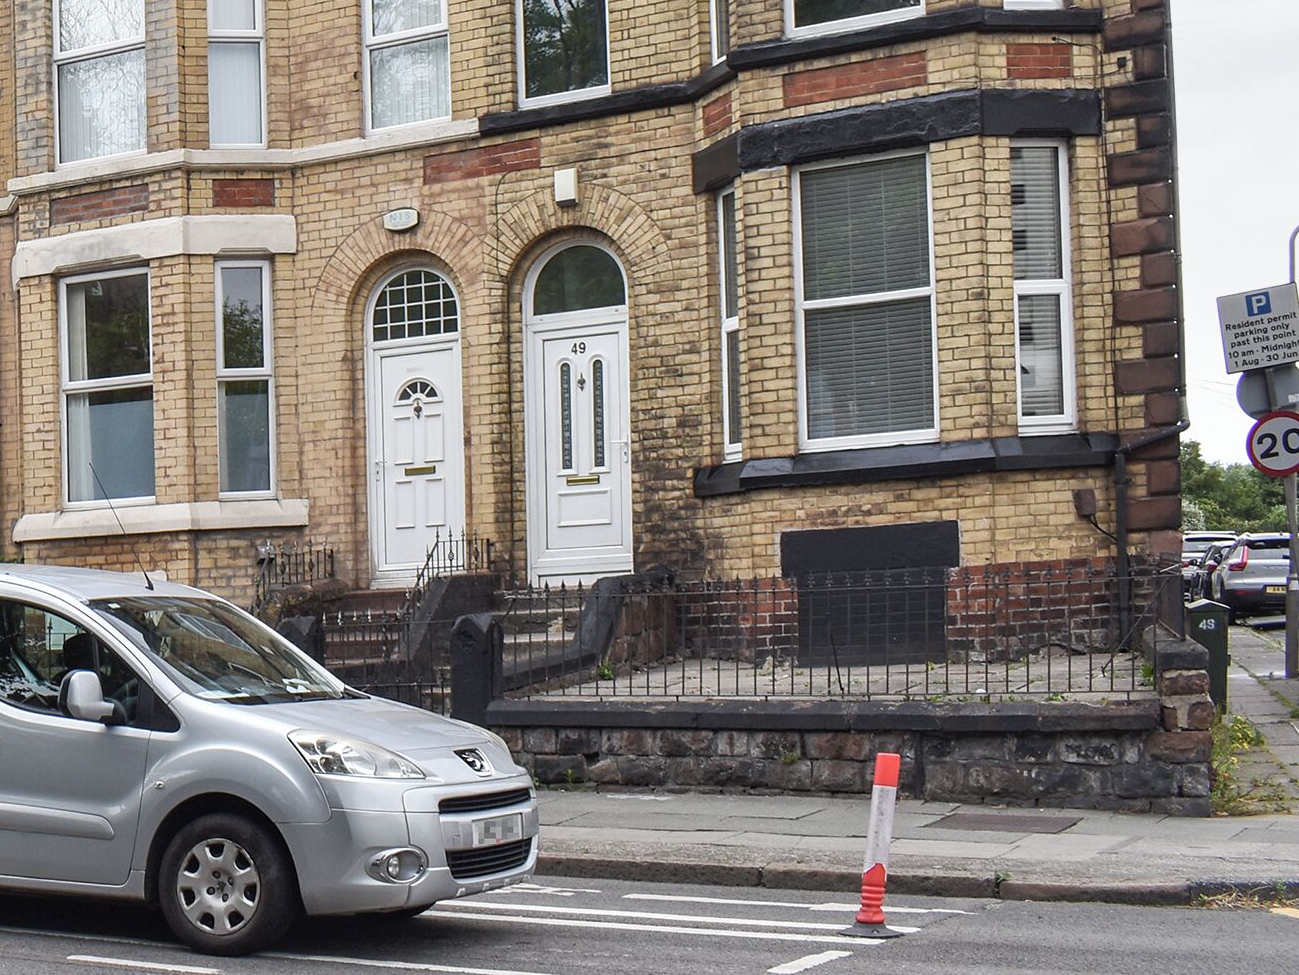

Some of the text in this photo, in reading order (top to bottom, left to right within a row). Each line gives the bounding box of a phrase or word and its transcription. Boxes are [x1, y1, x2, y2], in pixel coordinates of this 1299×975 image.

[1251, 294, 1266, 314] P
[1225, 311, 1297, 331] Resident permit
[1230, 330, 1296, 348] past this point
[1234, 322, 1290, 339] parking only
[571, 342, 586, 355] 49
[1228, 350, 1239, 359] 10
[1241, 349, 1254, 357] am
[1241, 358, 1259, 366] Aug
[1266, 353, 1279, 362] 30
[1282, 351, 1298, 359] Jun
[1257, 428, 1299, 460] 20
